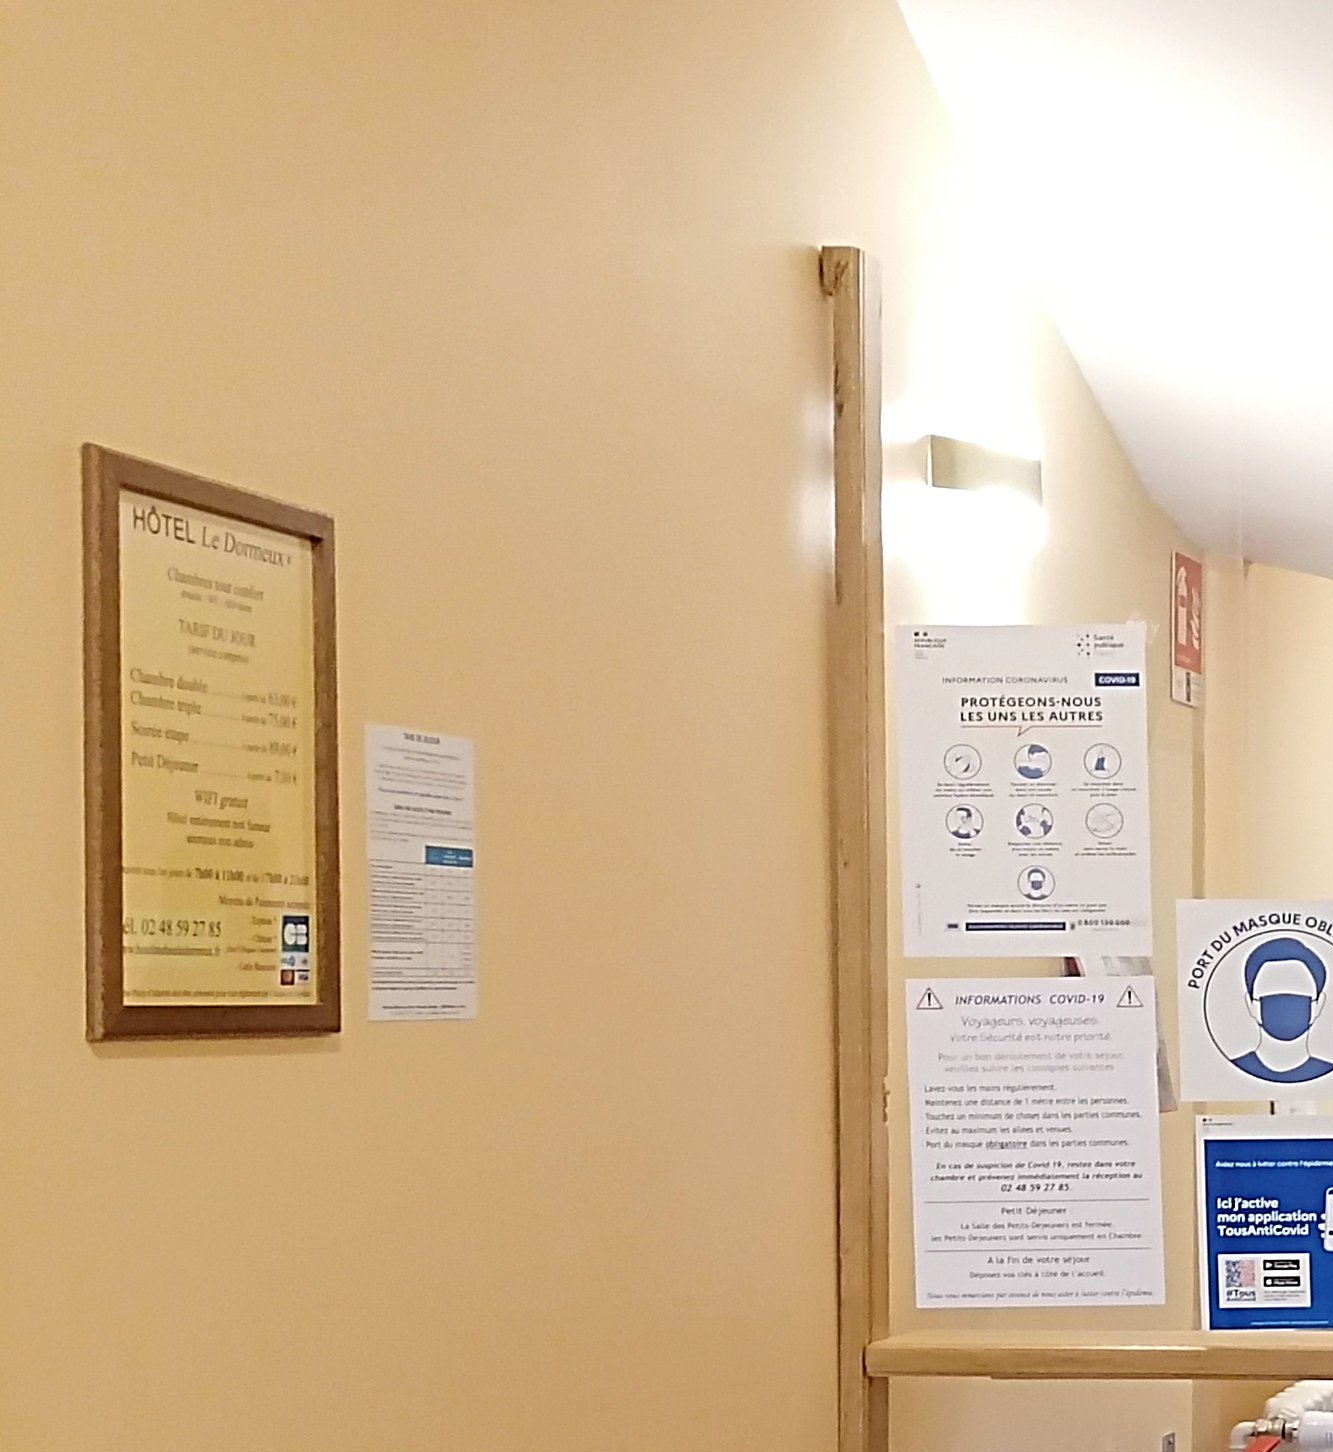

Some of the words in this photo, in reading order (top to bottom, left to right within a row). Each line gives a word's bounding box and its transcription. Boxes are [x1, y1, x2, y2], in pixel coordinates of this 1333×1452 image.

[133, 505, 196, 544] HÔTEL
[202, 526, 220, 550] Le
[942, 676, 1003, 684] INFORMATION
[1005, 676, 1068, 684] CORONAVIRUS
[1098, 676, 1136, 684] COVID-19
[961, 694, 1102, 707] PROTÉGEONS-NOUS
[960, 711, 983, 722] LES
[987, 711, 1017, 722] UNS
[1021, 711, 1044, 722] LES
[1049, 711, 1103, 722] AUTRES
[141, 918, 156, 936] 02
[158, 919, 173, 936] 48
[176, 919, 190, 937] 59
[192, 920, 207, 937] 27
[209, 920, 222, 938] 85
[1188, 949, 1214, 990] PORT
[1210, 930, 1232, 953] DU
[1232, 912, 1301, 937] MASQUE
[955, 994, 1042, 1005] INFORMATIONS
[1049, 994, 1105, 1005] COVID-19
[951, 1033, 978, 1042] Votre
[1024, 1033, 1042, 1042] est
[1044, 1033, 1072, 1042] notre
[1001, 1183, 1012, 1192] 02
[1015, 1183, 1027, 1192] 48
[1030, 1183, 1041, 1192] 59
[1043, 1183, 1056, 1192] 27
[1217, 1197, 1233, 1209] Ici
[1233, 1197, 1279, 1211] j'active
[1001, 1206, 1022, 1215] Petit
[1217, 1212, 1246, 1222] mon
[1248, 1209, 1317, 1225] application
[1217, 1223, 1310, 1237] TousAntiCovid
[996, 1256, 1005, 1264] la
[1007, 1256, 1020, 1264] fin
[1022, 1256, 1034, 1264] de
